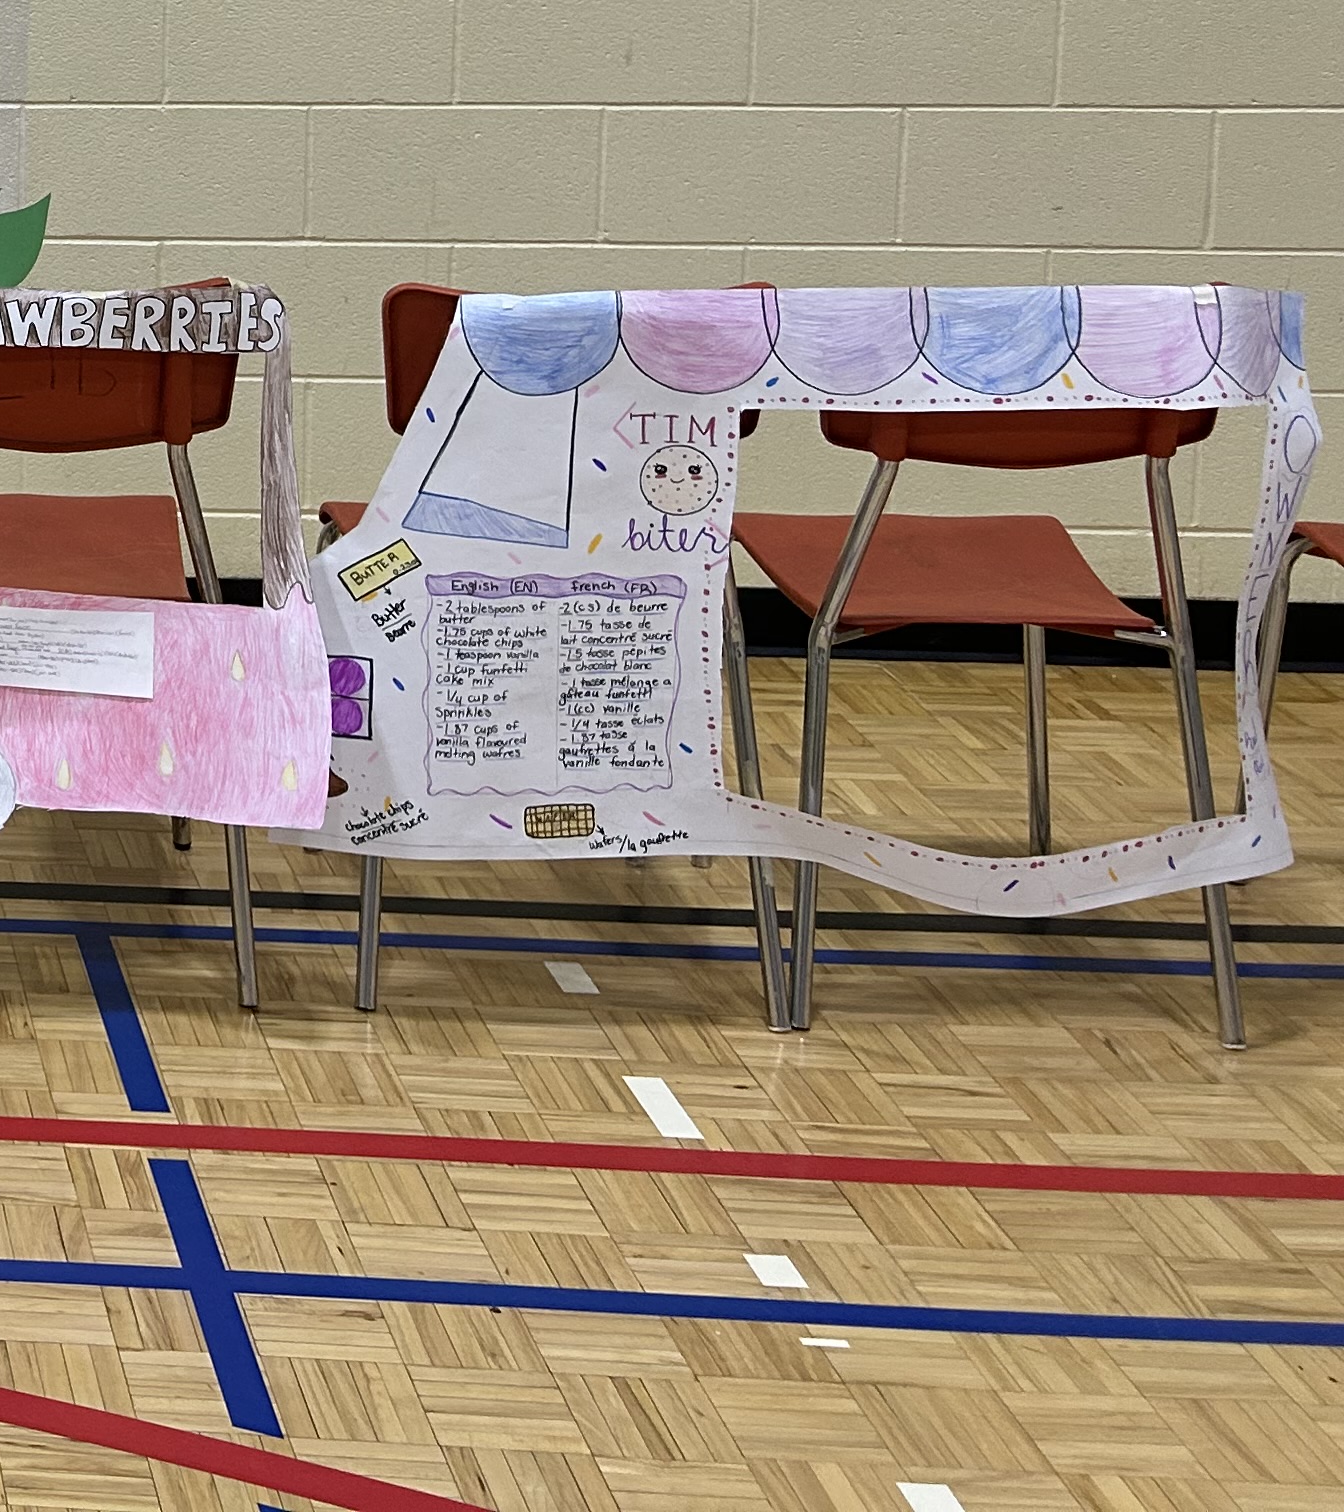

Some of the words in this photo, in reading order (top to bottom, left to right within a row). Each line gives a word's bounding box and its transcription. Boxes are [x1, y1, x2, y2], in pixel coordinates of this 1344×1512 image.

[630, 412, 718, 447] TIM
[452, 580, 499, 595] English
[510, 578, 538, 595] (EN)
[571, 581, 615, 592] french
[625, 581, 657, 595] (FR)
[457, 600, 525, 618] tablespoons
[532, 601, 547, 611] of
[607, 600, 621, 612] de
[630, 599, 668, 612] beurre
[439, 614, 476, 624] butter
[600, 618, 632, 631] tasse
[638, 616, 651, 628] de
[471, 628, 493, 638] cups
[498, 626, 511, 636] of
[514, 626, 547, 638] white
[495, 638, 523, 649] chips
[473, 677, 494, 686] mix
[468, 694, 488, 704] cup
[494, 690, 508, 701] of
[506, 720, 519, 730] of
[645, 740, 655, 751] la
[609, 754, 664, 767] fondante
